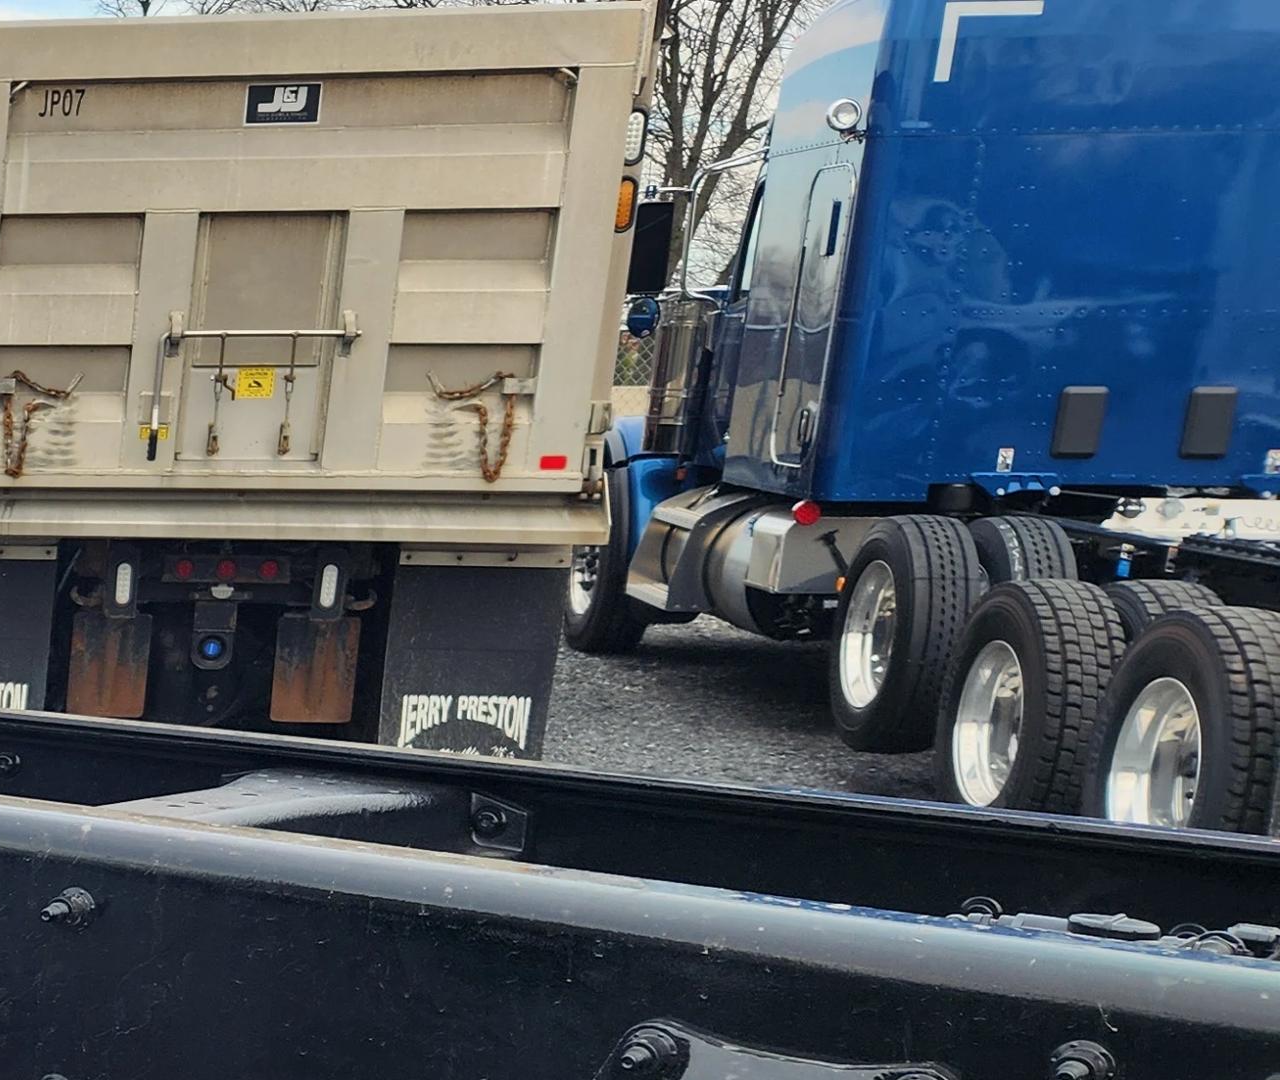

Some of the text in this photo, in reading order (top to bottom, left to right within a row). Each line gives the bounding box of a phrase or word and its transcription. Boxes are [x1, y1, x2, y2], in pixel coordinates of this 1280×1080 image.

[38, 89, 85, 117] JP07
[257, 86, 308, 112] J&J
[397, 694, 532, 750] JERRY PRESTON
